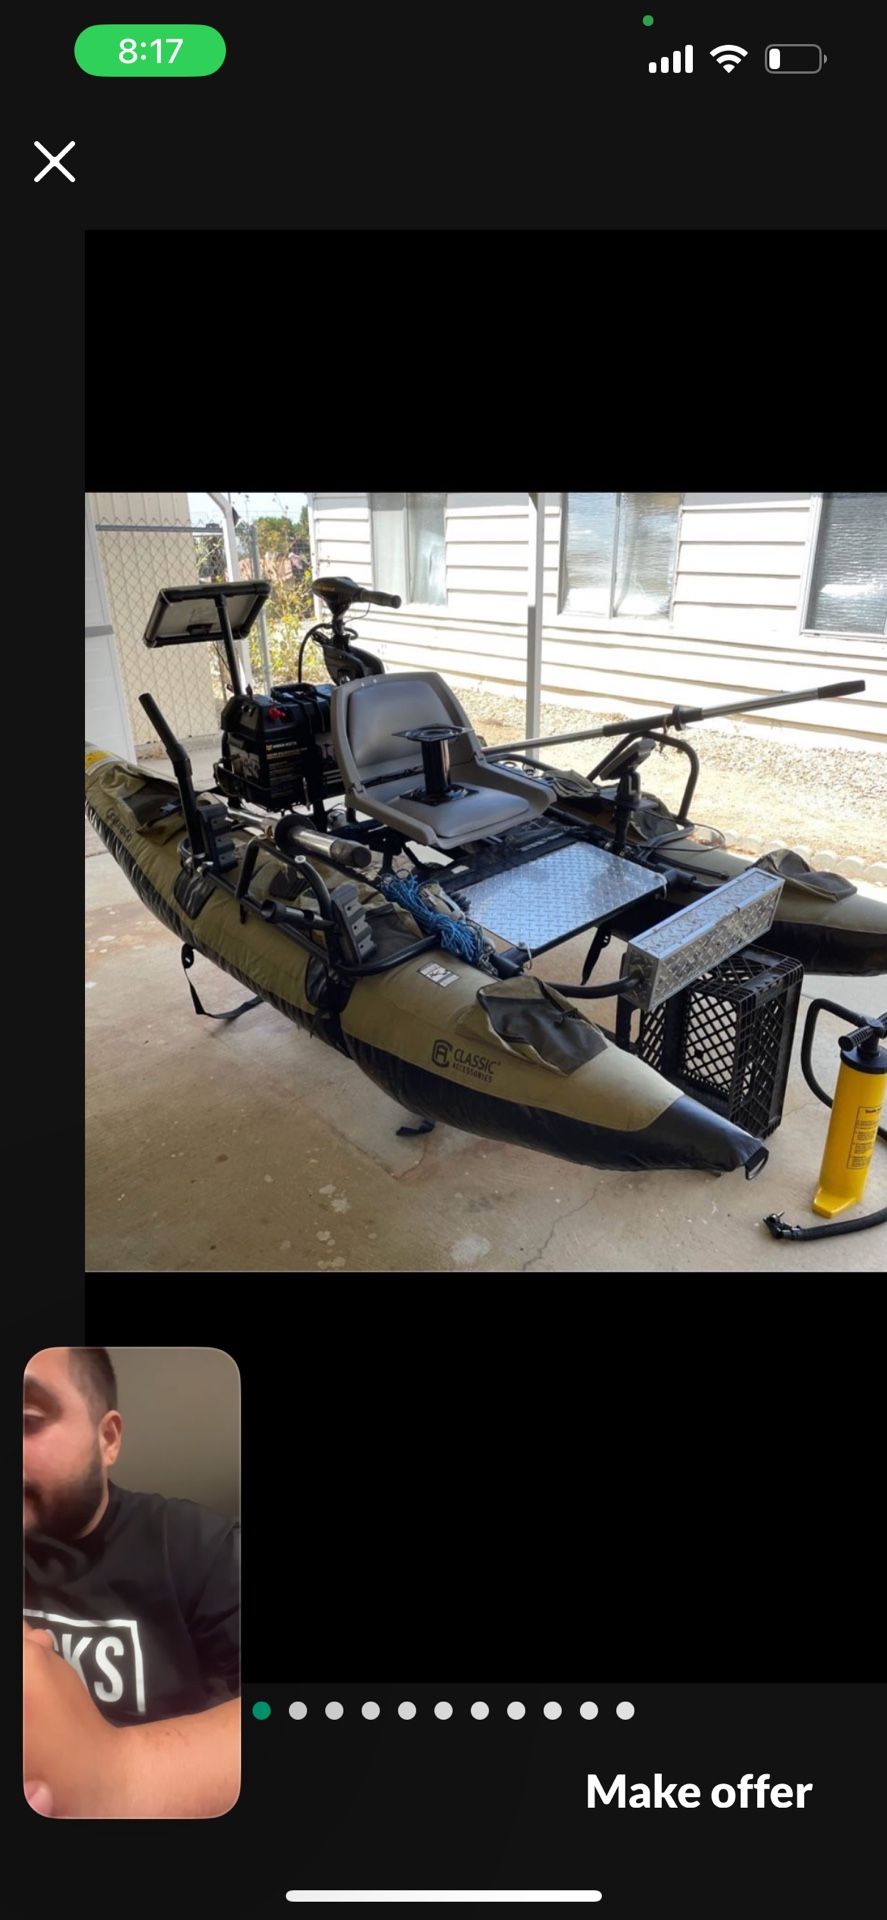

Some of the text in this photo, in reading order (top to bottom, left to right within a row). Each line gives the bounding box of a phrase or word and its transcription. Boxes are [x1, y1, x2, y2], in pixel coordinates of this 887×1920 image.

[118, 38, 183, 64] 8:17
[453, 1047, 497, 1075] CLASSIC
[45, 1628, 124, 1702] KS
[587, 1773, 813, 1809] Make offer
